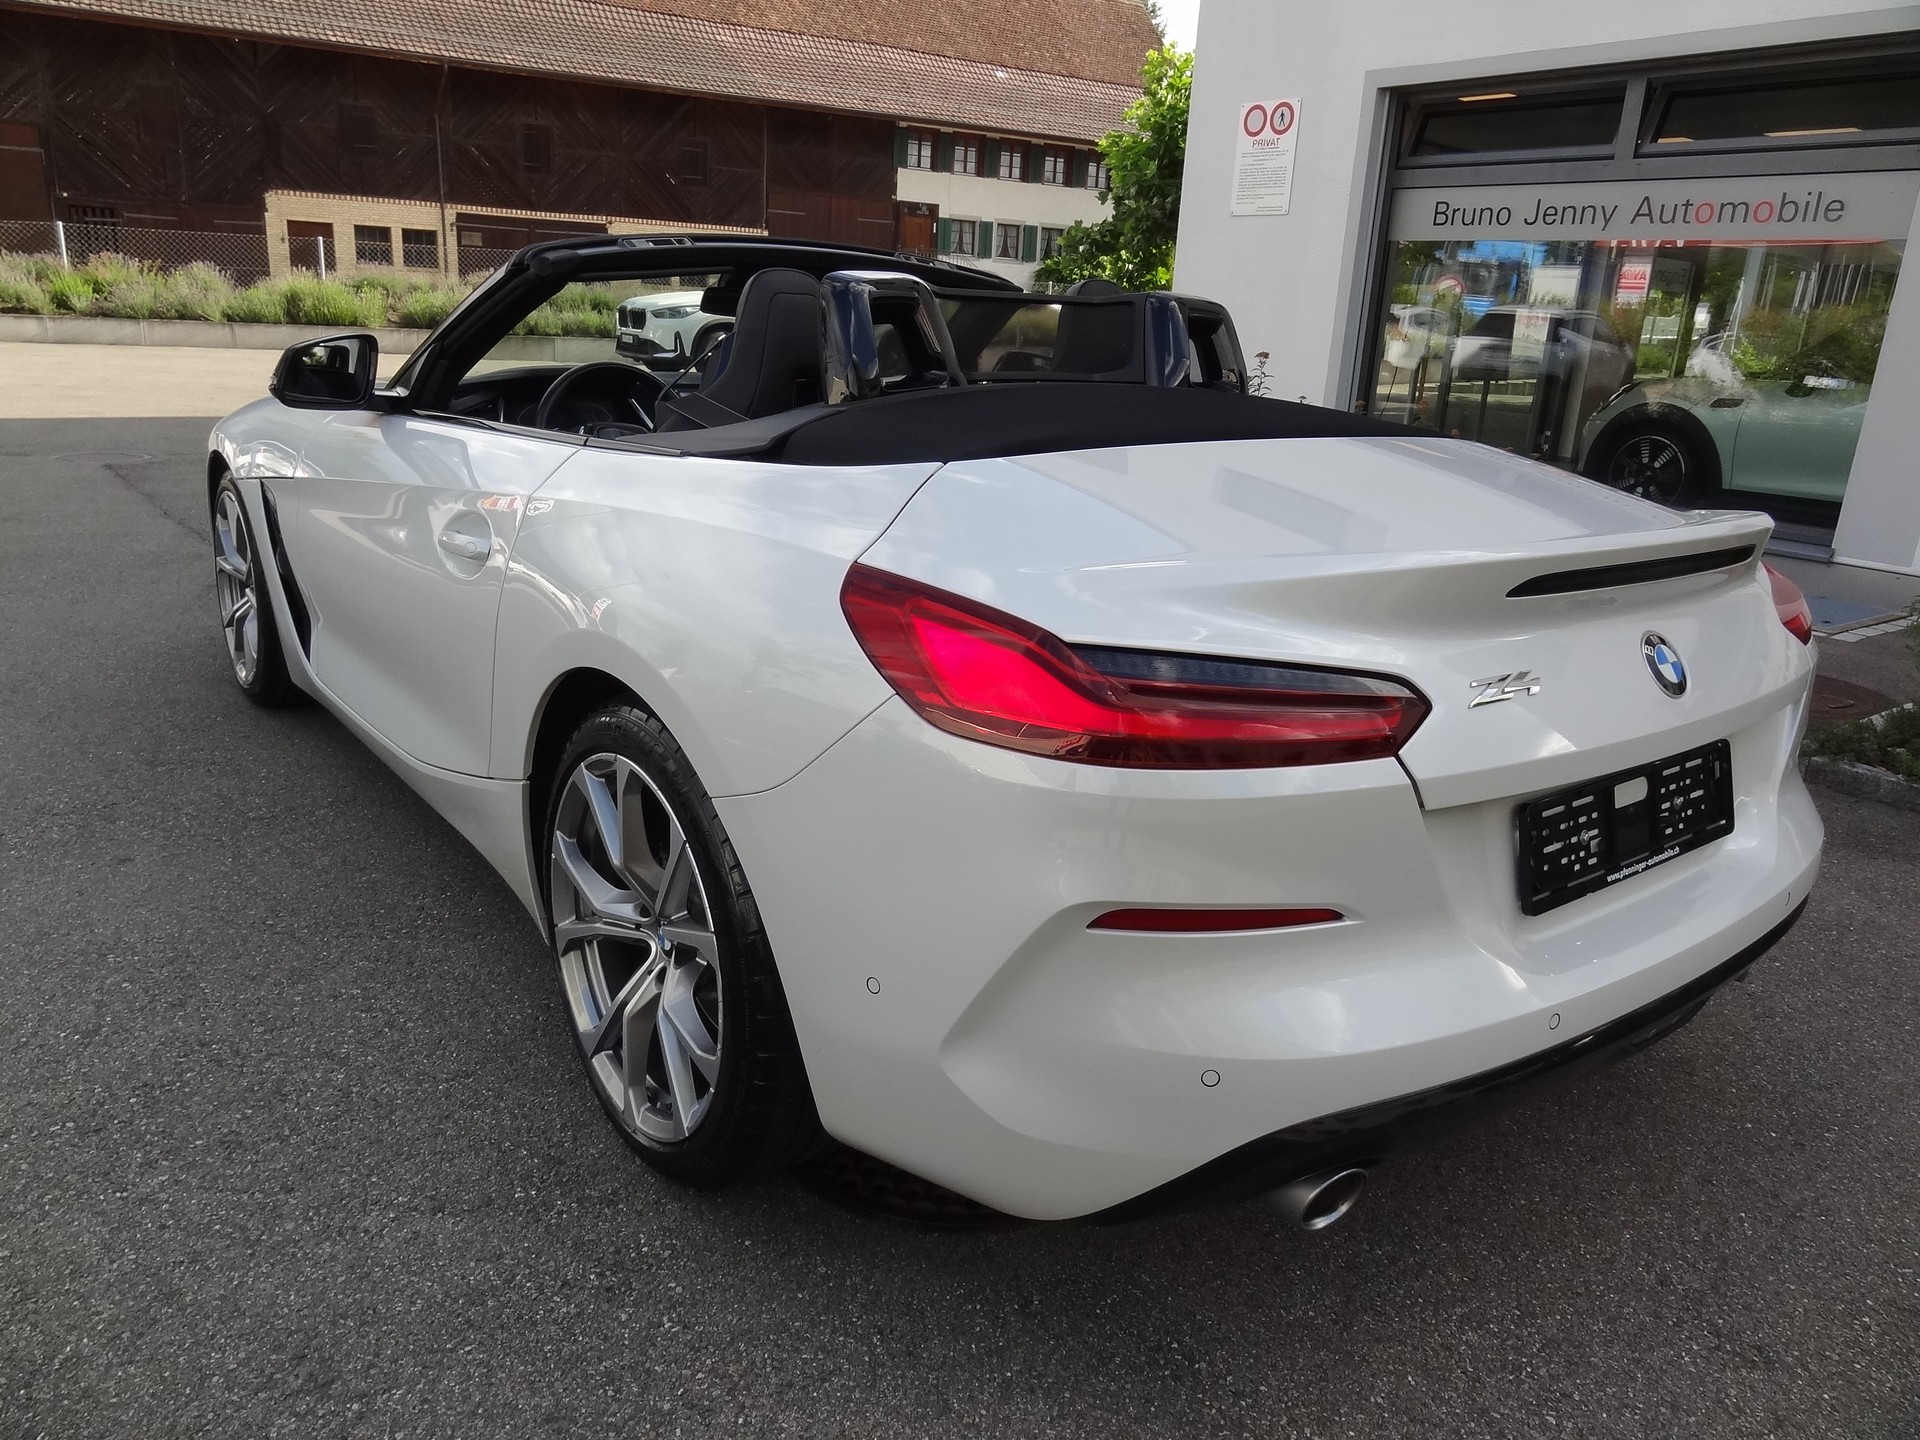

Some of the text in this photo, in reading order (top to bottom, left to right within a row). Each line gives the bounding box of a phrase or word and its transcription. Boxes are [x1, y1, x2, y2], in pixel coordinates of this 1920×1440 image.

[1252, 137, 1281, 148] PRIVAT
[1432, 191, 1846, 232] Bruno Jenny Automobile
[1468, 668, 1541, 709] Z4
[1606, 845, 1680, 883] www.pfenninger-automobile.ch
